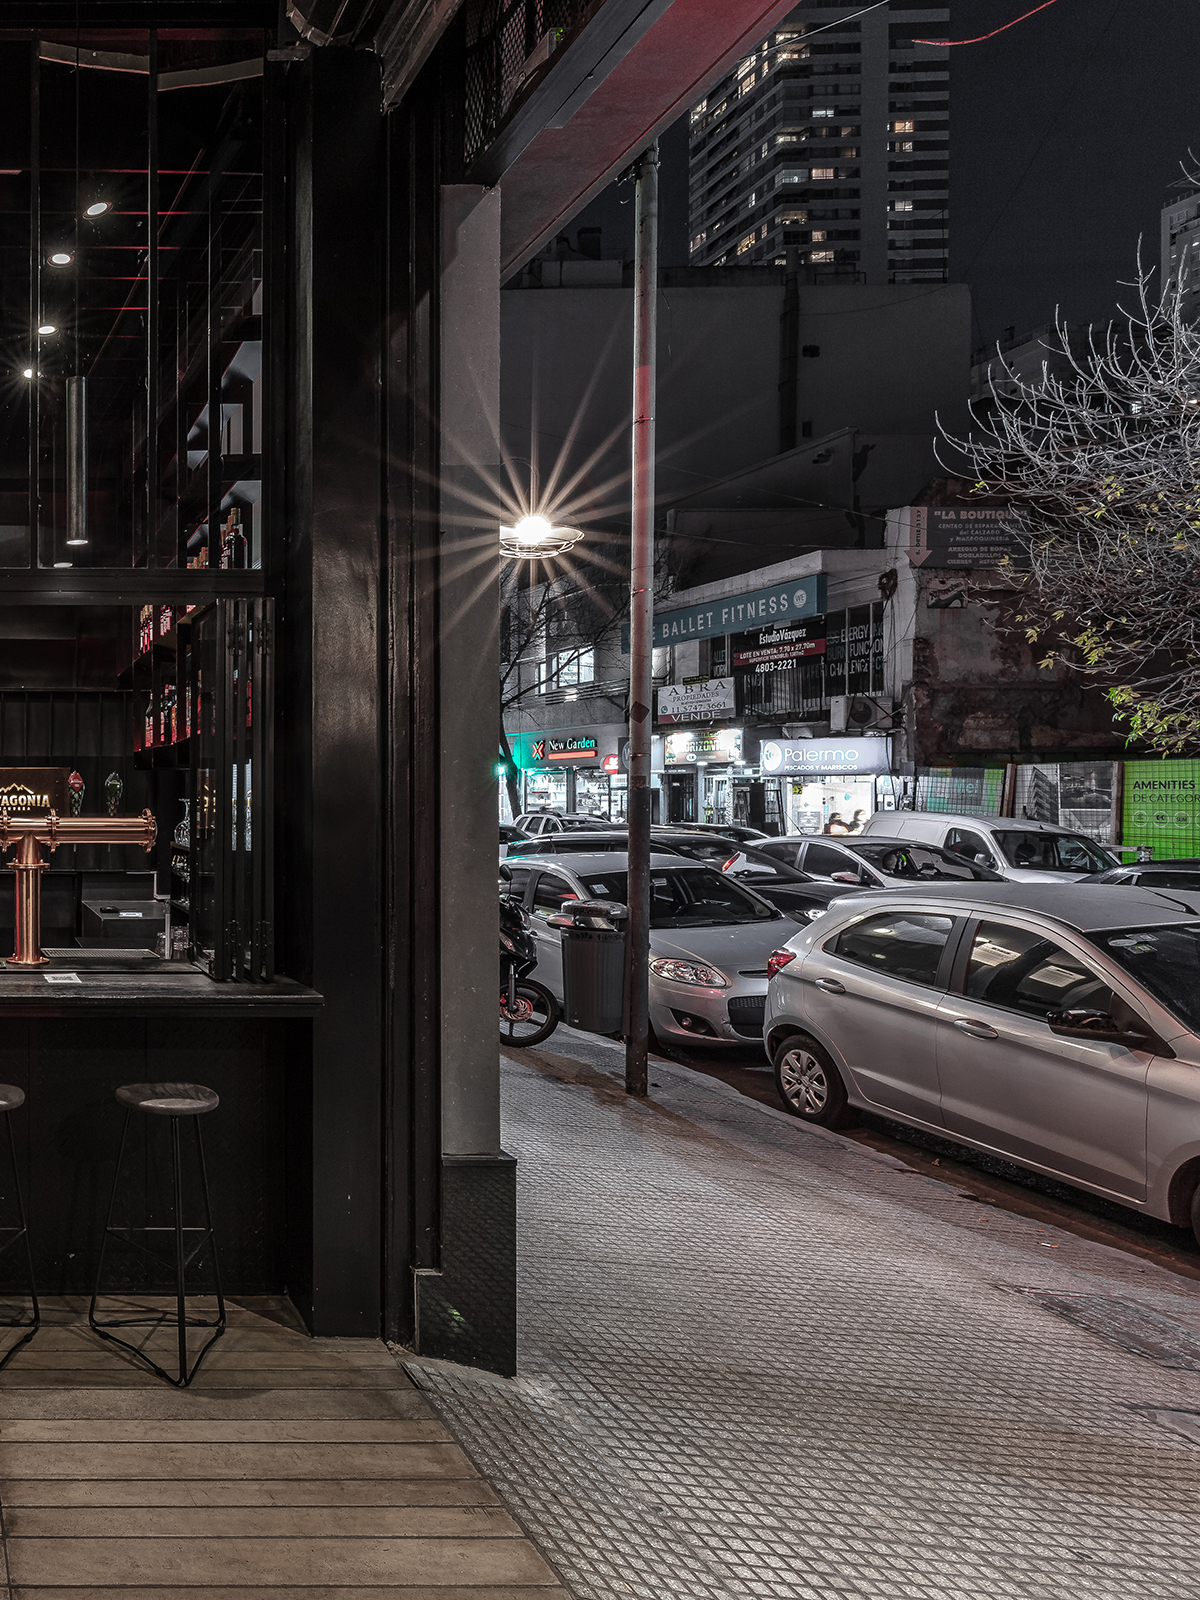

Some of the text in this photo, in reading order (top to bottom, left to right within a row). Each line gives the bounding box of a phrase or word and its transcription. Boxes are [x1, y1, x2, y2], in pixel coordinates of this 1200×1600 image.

[662, 612, 714, 638] BALLET
[722, 593, 788, 625] FITNESS
[841, 624, 869, 642] EERGY
[849, 638, 883, 657] FUNCIO
[740, 652, 752, 660] LOTE
[755, 659, 797, 673] 4803-2221
[668, 680, 726, 696] ABRA
[672, 691, 719, 702] PROPIEDADES
[671, 711, 721, 722] VENDE
[549, 737, 596, 750] New Garden
[784, 748, 859, 761] Palermo
[1133, 780, 1195, 789] AMENITIES
[1134, 794, 1148, 803] DE
